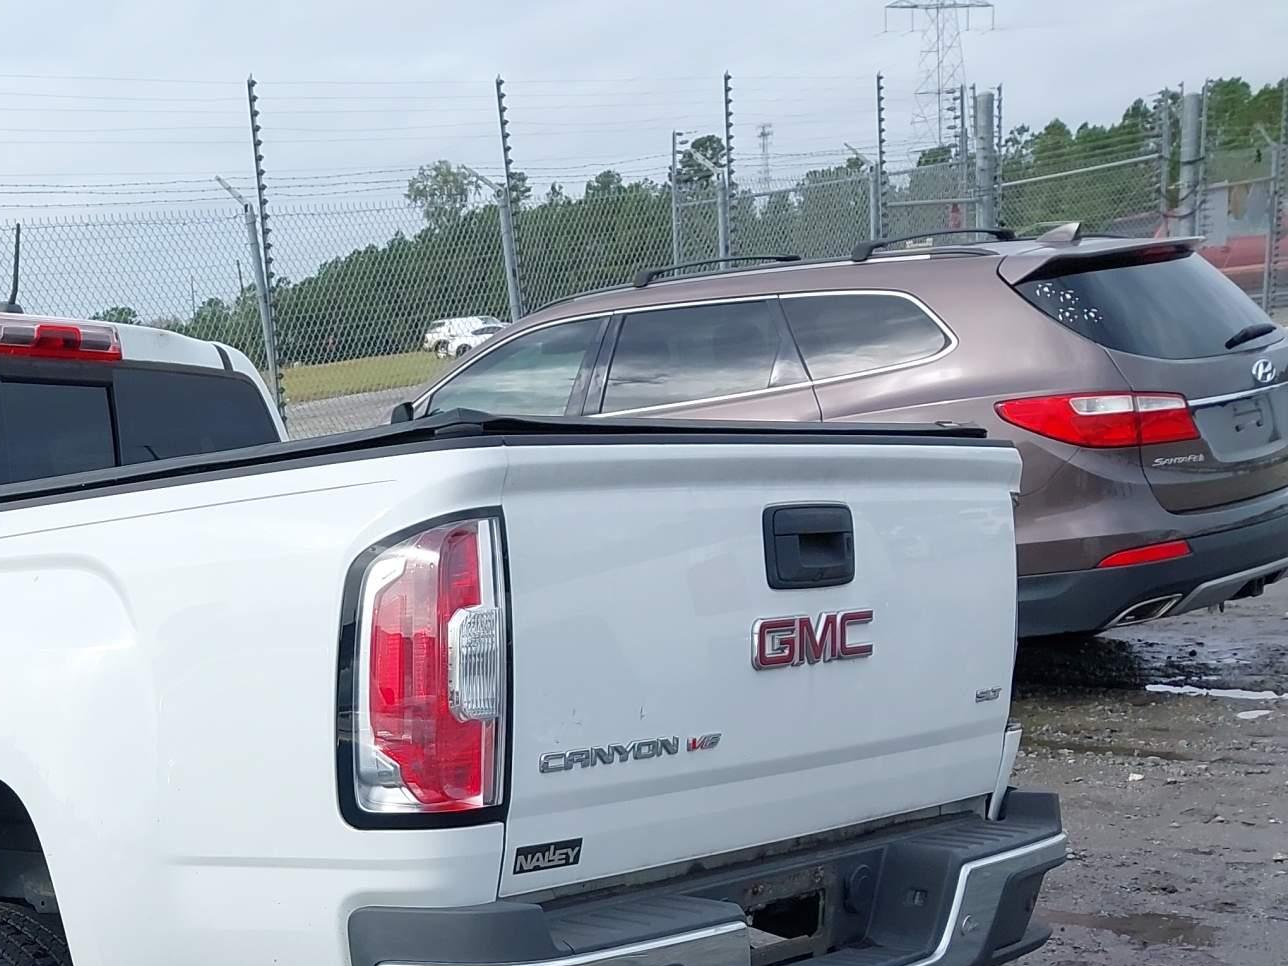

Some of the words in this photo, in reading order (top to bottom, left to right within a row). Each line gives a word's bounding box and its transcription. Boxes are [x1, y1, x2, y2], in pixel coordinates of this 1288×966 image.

[751, 608, 874, 671] GMC
[539, 736, 679, 774] CANYON
[685, 733, 722, 752] V6
[515, 844, 580, 873] NALLEY
